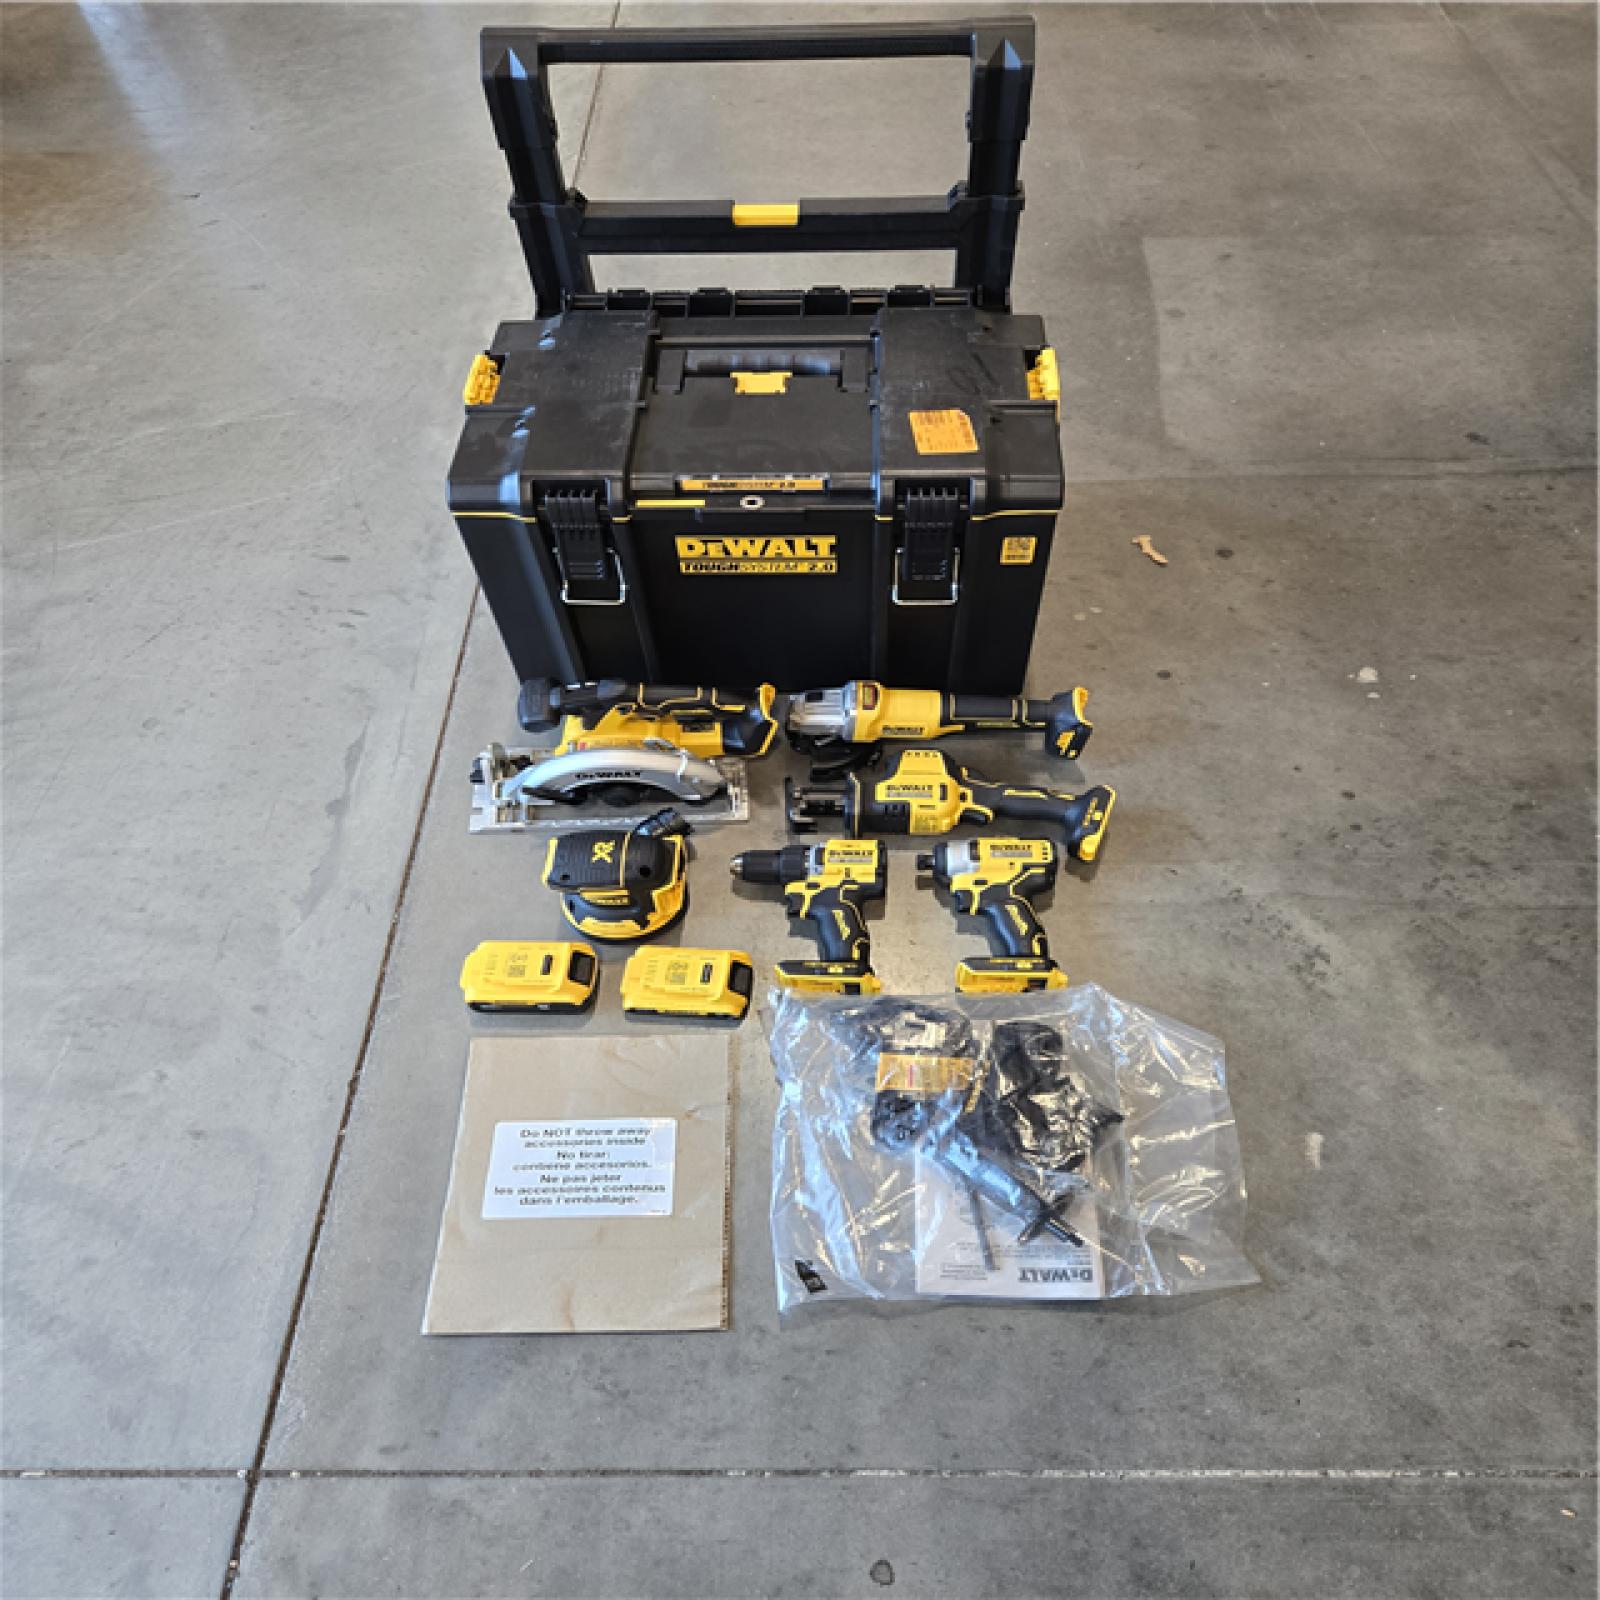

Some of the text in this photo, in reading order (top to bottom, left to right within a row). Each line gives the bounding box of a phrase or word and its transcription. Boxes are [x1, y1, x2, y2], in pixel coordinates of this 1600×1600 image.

[676, 535, 836, 558] DEWALT
[520, 1127, 651, 1138] Do NOT throw away
[524, 1137, 646, 1148] accessories inside
[556, 1151, 575, 1160] No
[512, 1162, 571, 1171] contiene
[539, 1174, 621, 1185] Ne pas jeter
[494, 1185, 666, 1196] les accessoires contenus
[519, 1196, 553, 1206] dans
[1019, 1268, 1093, 1282] DEWALT
